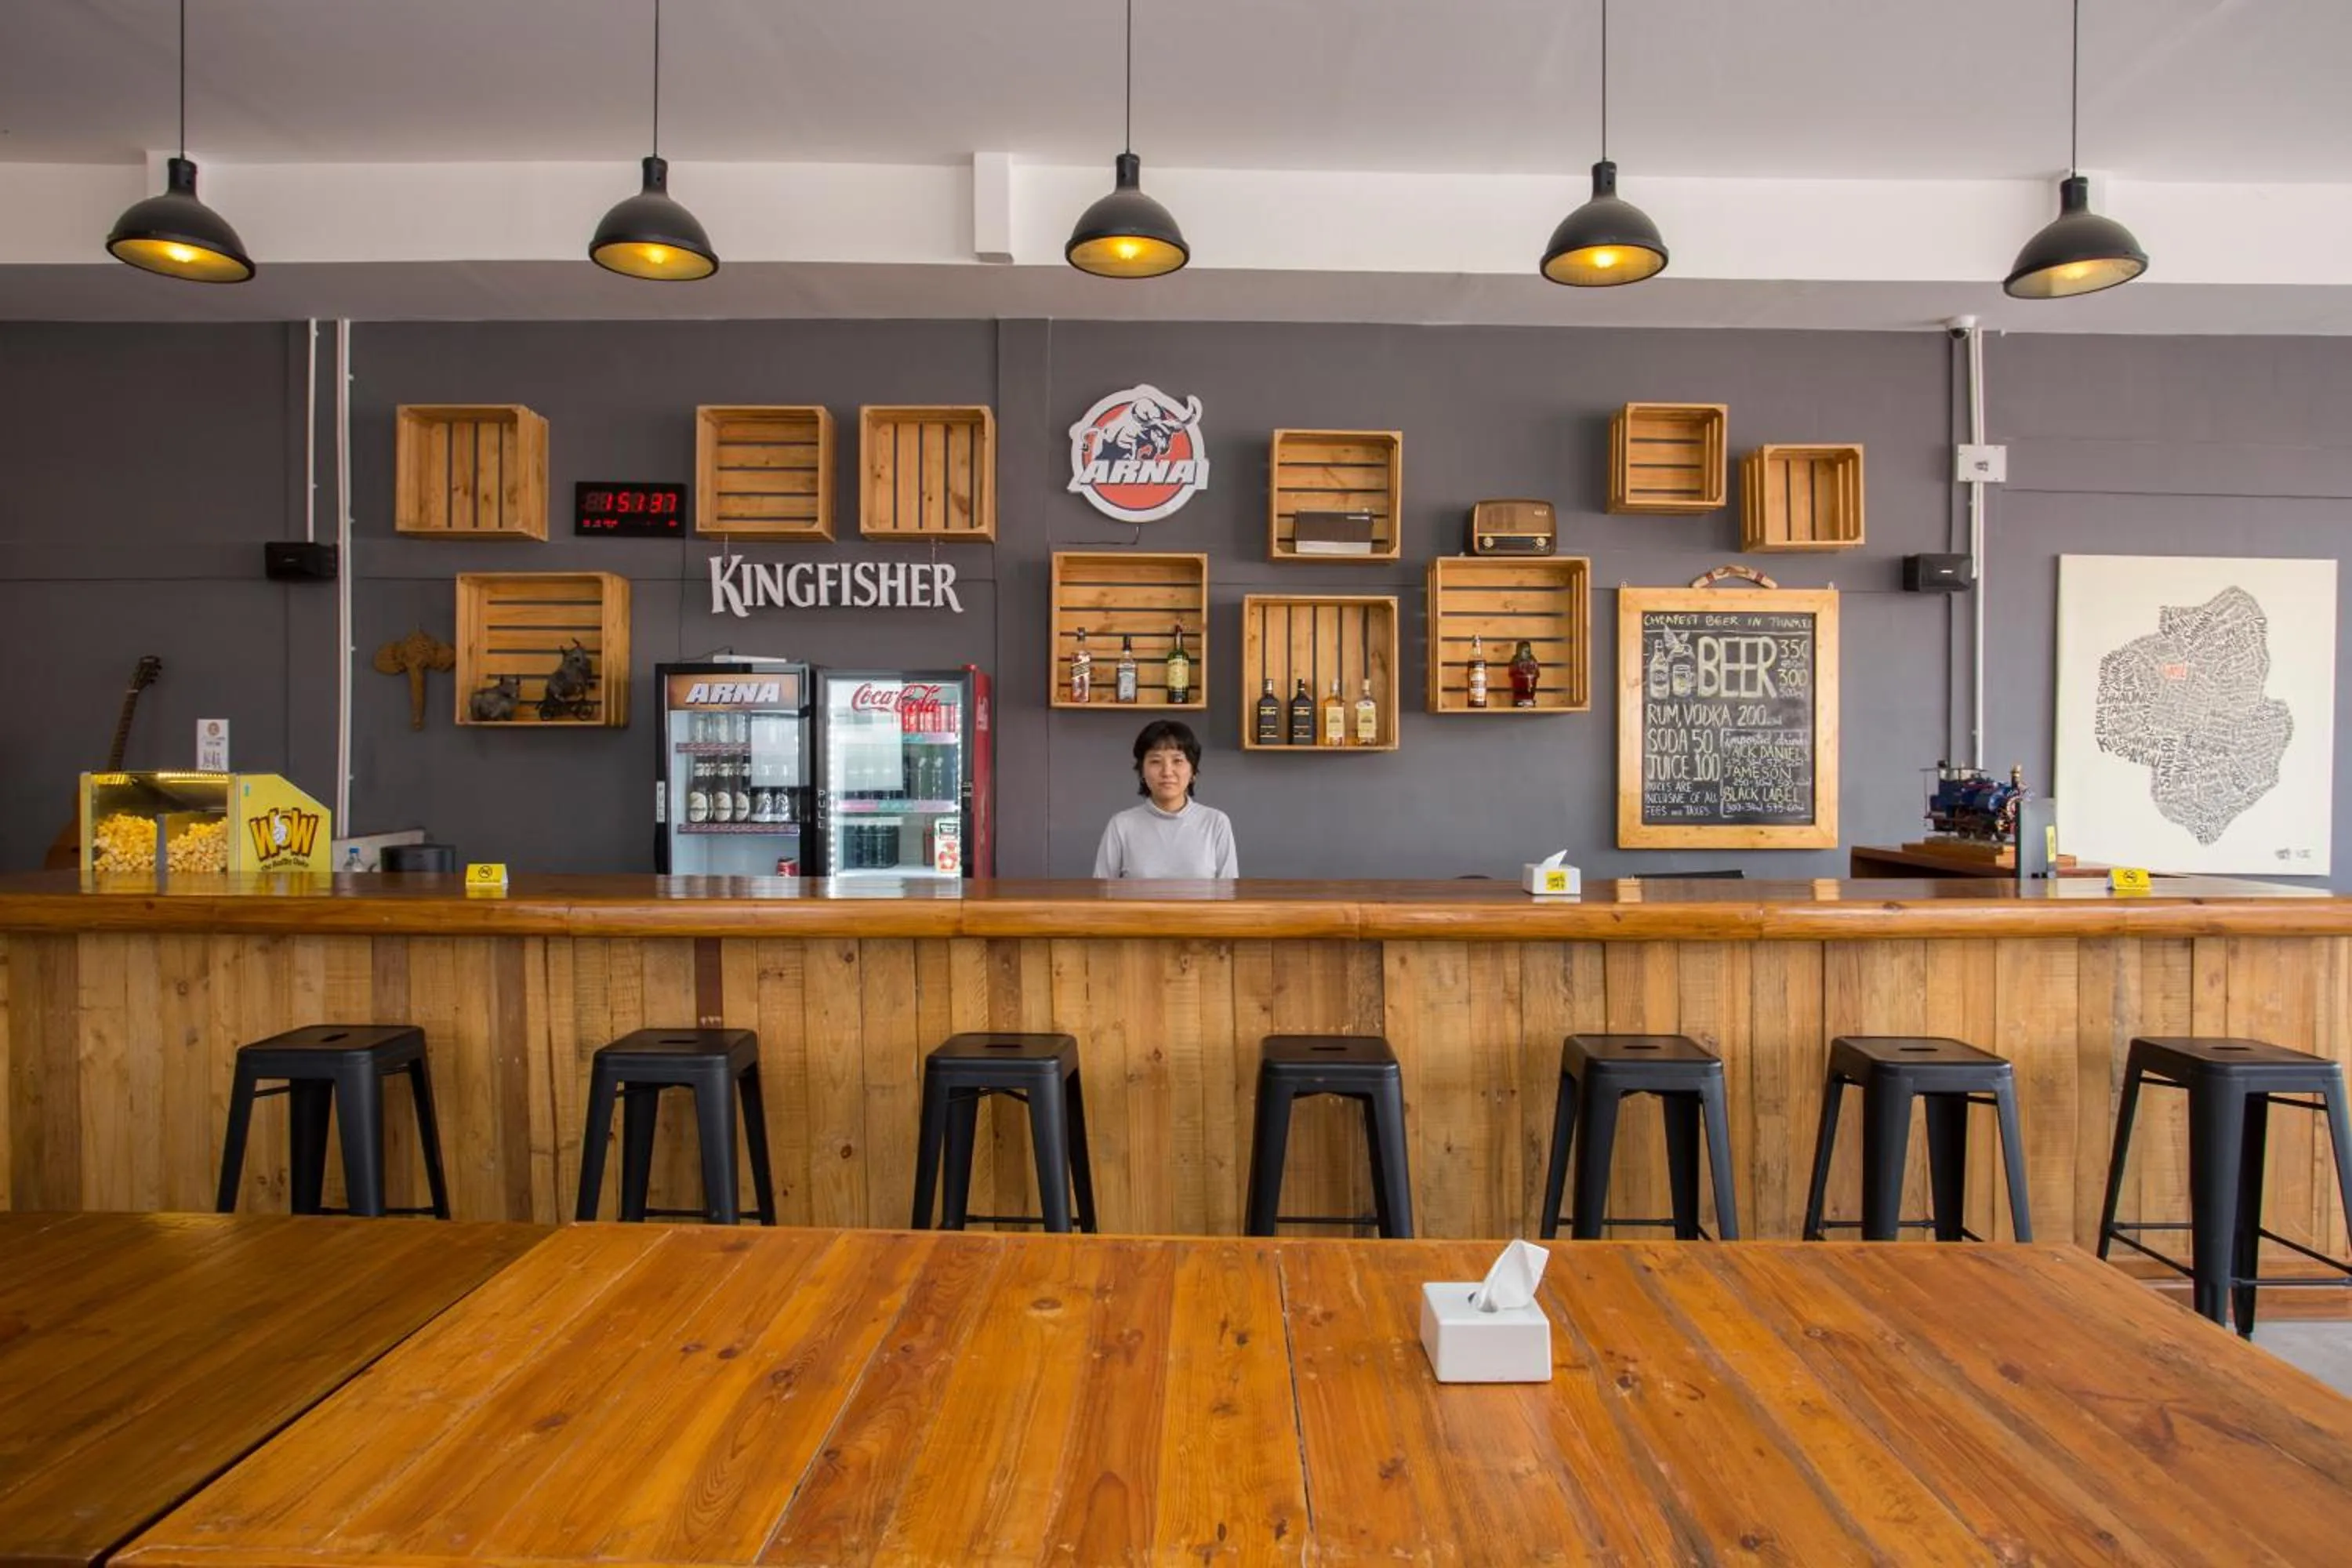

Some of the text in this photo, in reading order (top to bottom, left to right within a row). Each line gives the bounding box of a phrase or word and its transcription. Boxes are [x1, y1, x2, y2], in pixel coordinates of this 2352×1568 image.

[1079, 460, 1197, 485] ARNA
[710, 555, 964, 617] KINGFISHER
[1705, 615, 1739, 626] BEER
[1748, 617, 1762, 626] IN
[1697, 636, 1778, 699] BEER
[1777, 669, 1809, 687] 300
[685, 682, 782, 705] ARNA
[852, 683, 942, 712] Coca-Cola
[1737, 704, 1766, 726] 200
[1647, 728, 1714, 753] SODA 50
[1722, 745, 1757, 758] JACK
[1646, 753, 1721, 782] JUICE 100
[1724, 765, 1792, 779] JAMESON
[1690, 791, 1700, 804] OF
[1722, 786, 1798, 802] BLACK LABEL
[249, 808, 319, 862] WOW
